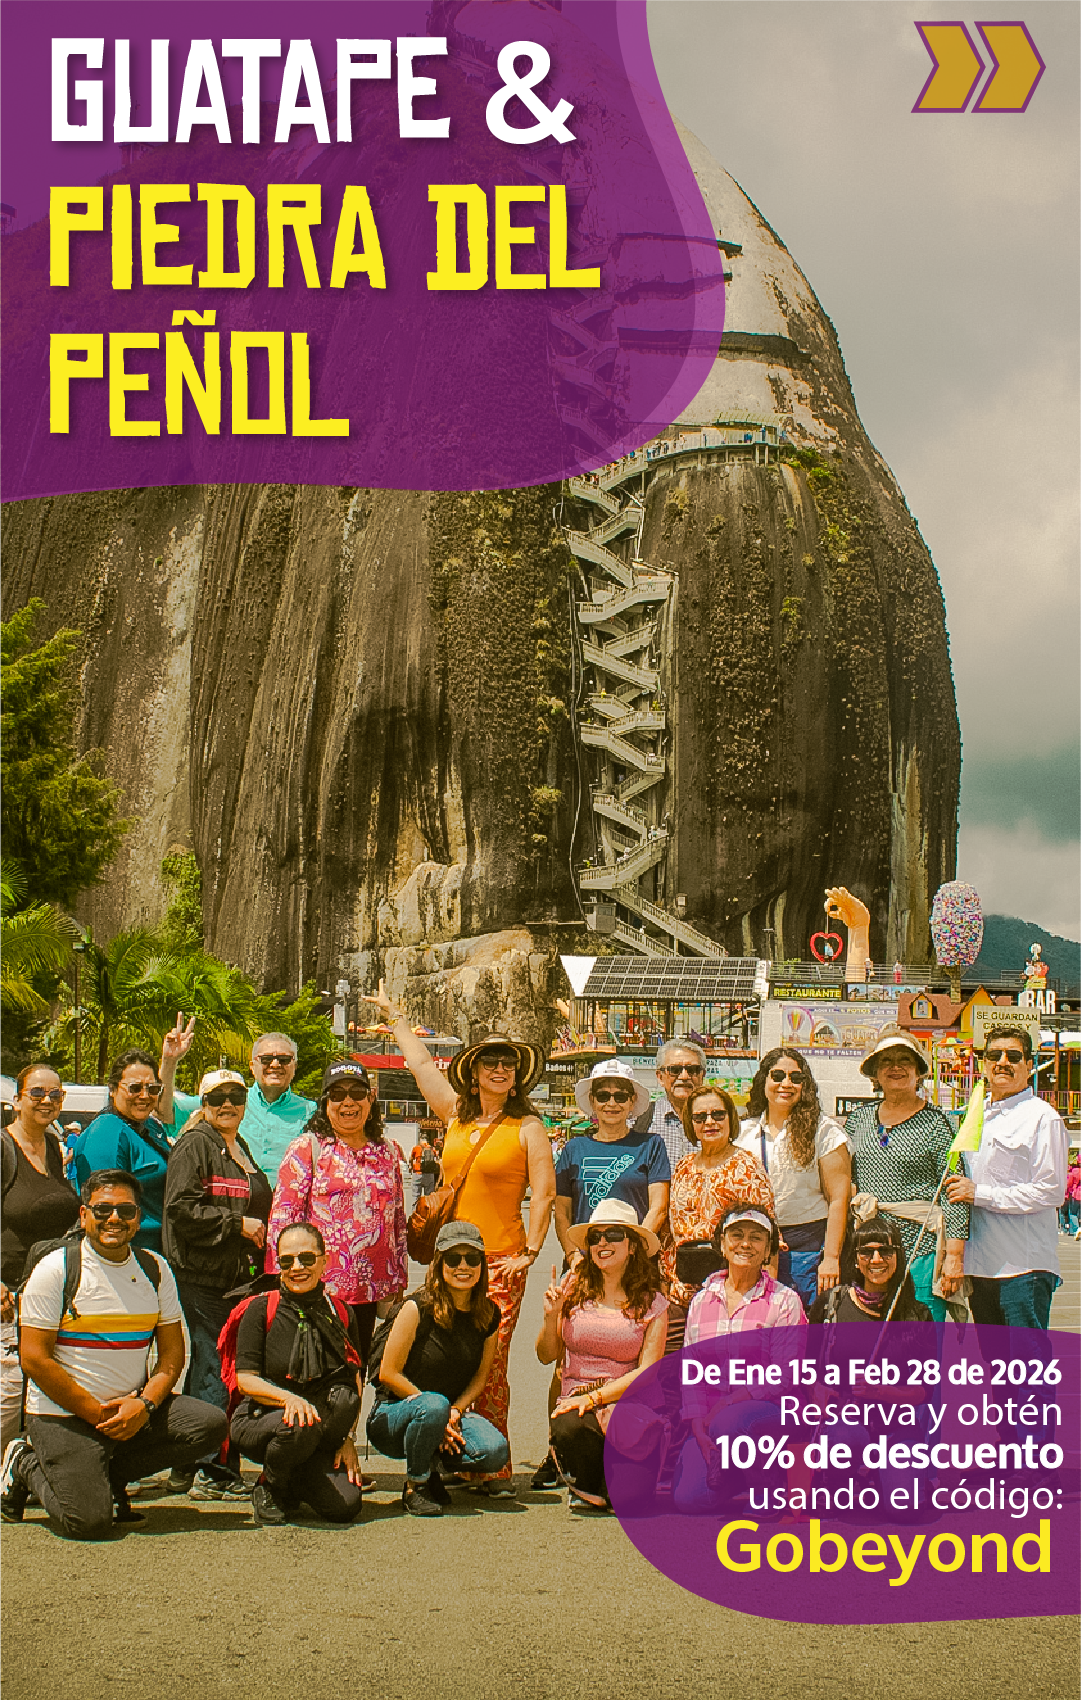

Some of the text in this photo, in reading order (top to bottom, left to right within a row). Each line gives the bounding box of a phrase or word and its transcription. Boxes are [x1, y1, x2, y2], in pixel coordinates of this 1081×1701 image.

[773, 988, 841, 998] RESTAURANTE
[1026, 989, 1056, 1014] BAR
[976, 1010, 1038, 1021] SE GUARDAN
[588, 1153, 635, 1210] adidas
